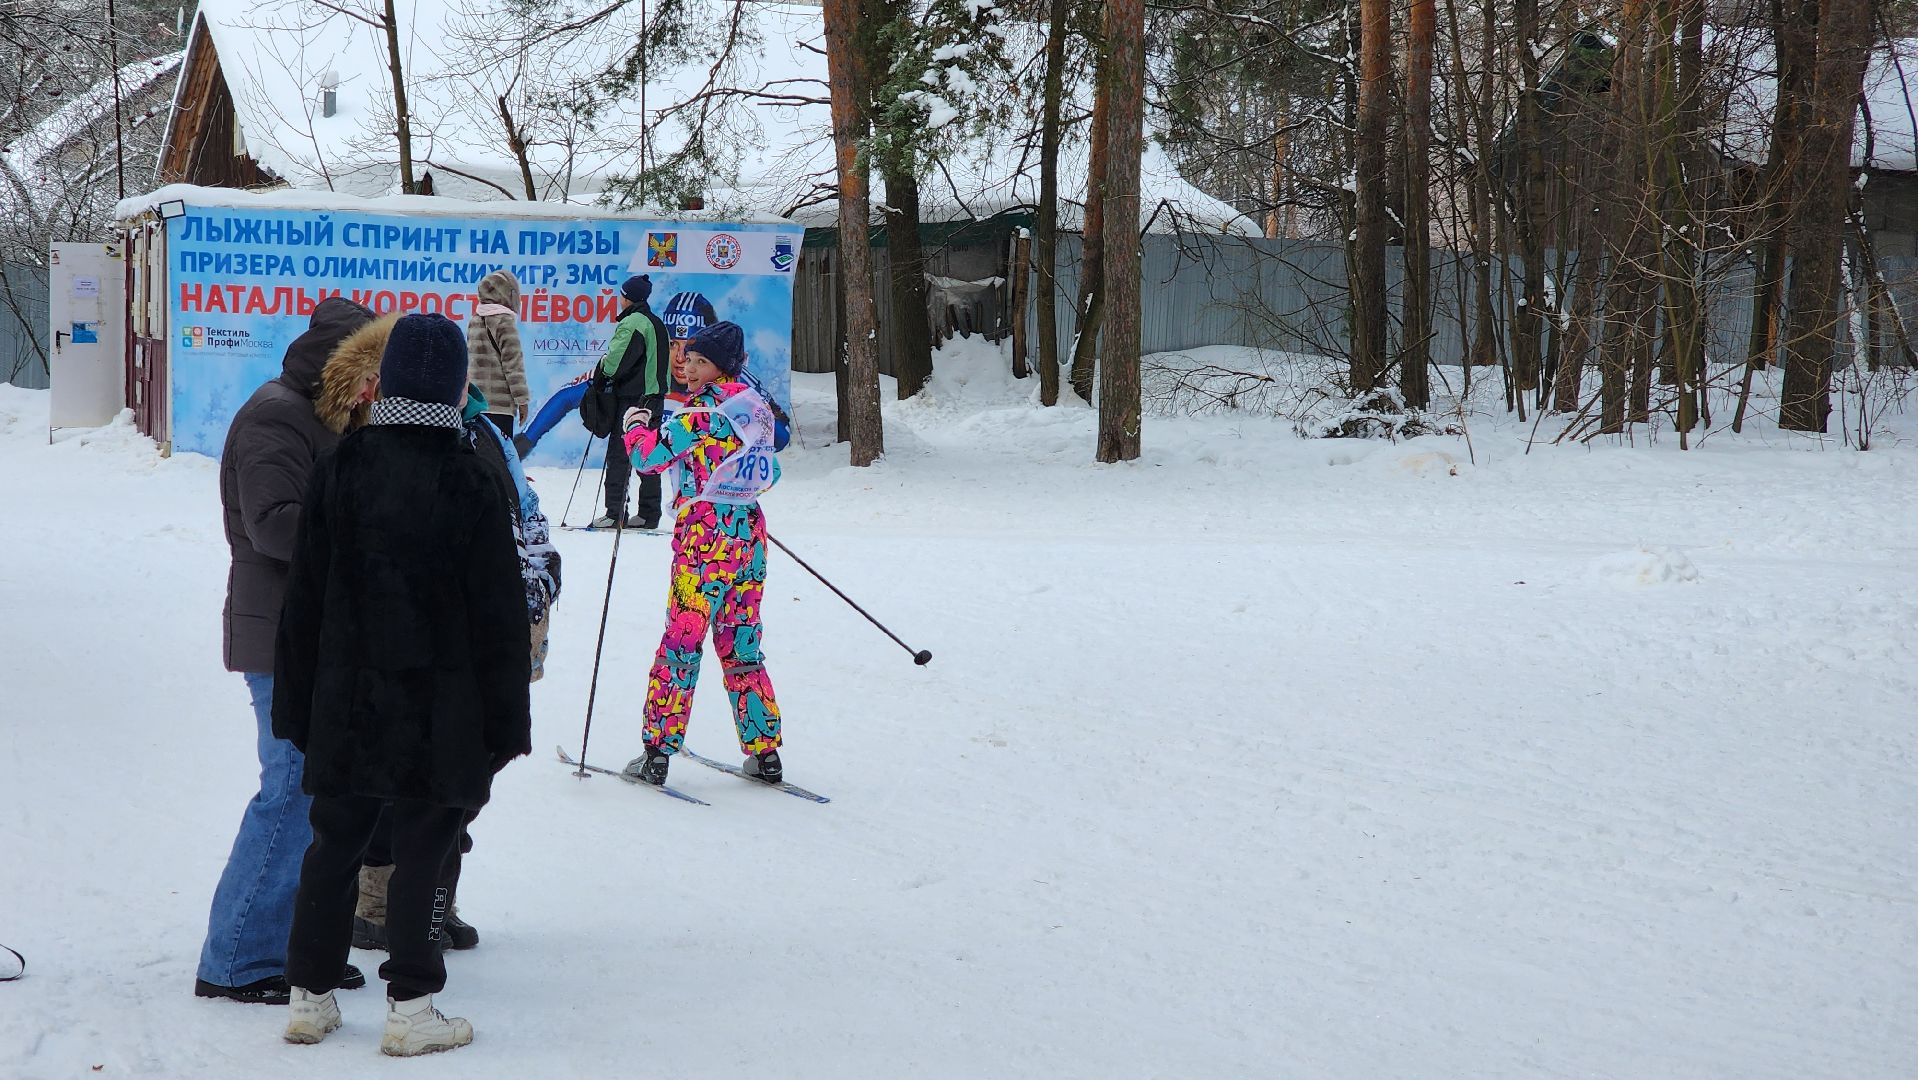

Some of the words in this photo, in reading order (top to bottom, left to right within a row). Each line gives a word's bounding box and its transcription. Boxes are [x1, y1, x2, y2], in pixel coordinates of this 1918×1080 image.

[181, 215, 333, 247] ЛЫЖНЫЙ
[342, 221, 462, 254] СПРИНТ
[470, 229, 510, 255] НА
[518, 230, 620, 256] ПРИЗЫ
[180, 251, 296, 277] ПРИЗЕРА
[566, 263, 619, 286] ЗМС
[352, 287, 618, 323] КОРОСТЁВОЙ
[206, 327, 250, 338] Текстиль
[663, 313, 706, 328] LUKOIL
[533, 338, 581, 351] MONA
[584, 339, 610, 351] LIZ
[735, 454, 769, 481] 189
